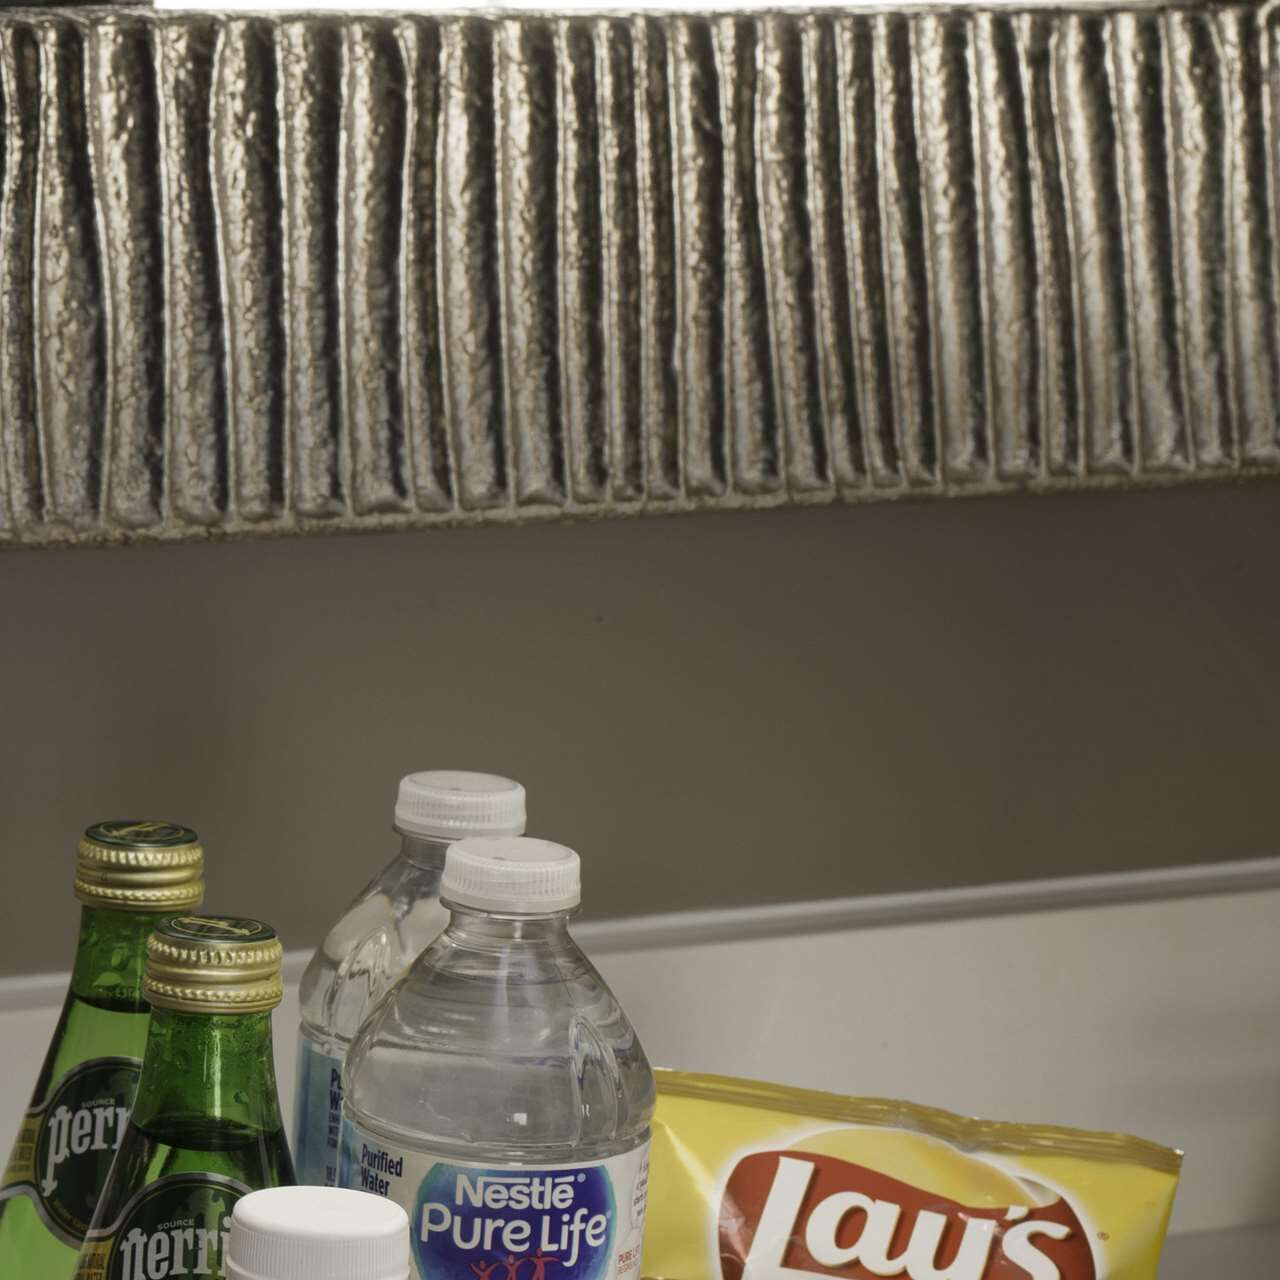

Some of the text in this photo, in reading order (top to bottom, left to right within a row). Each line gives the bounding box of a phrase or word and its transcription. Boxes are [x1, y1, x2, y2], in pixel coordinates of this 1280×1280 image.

[361, 1144, 403, 1178] Purified
[360, 1165, 390, 1196] Water
[455, 1174, 576, 1210] Nestlé
[157, 1219, 194, 1230] SOURCE
[421, 1202, 608, 1268] Pure Life
